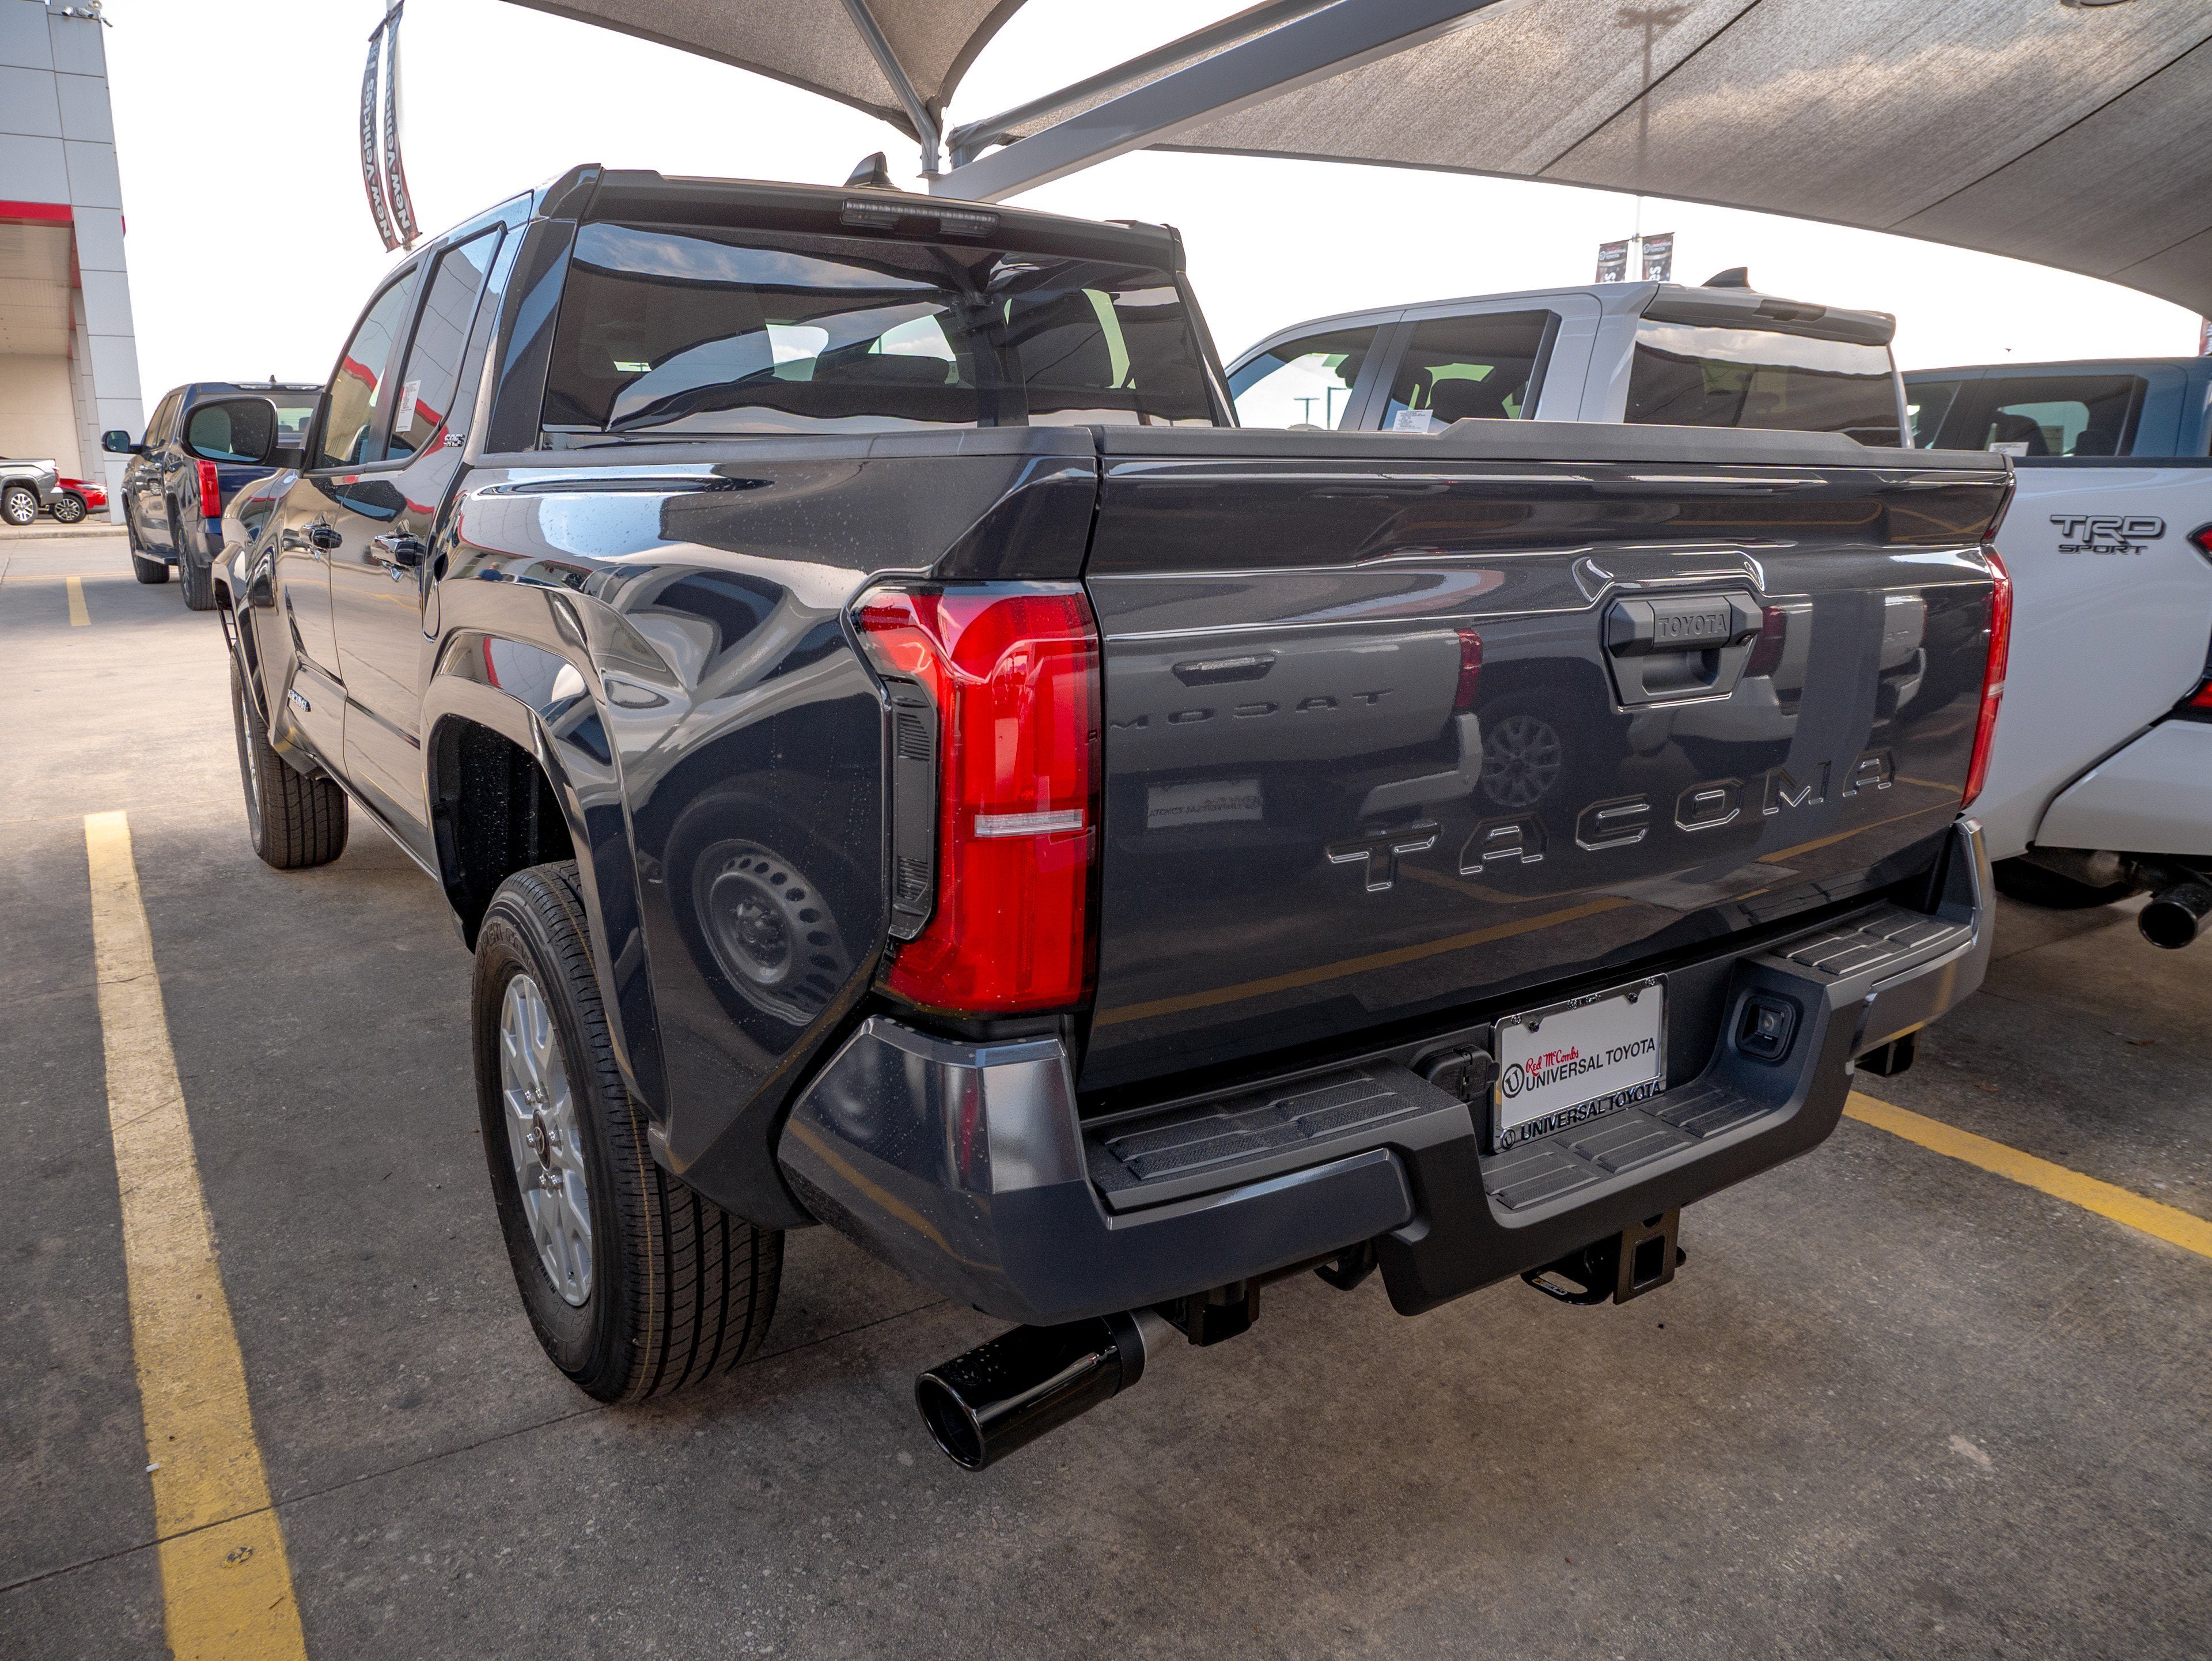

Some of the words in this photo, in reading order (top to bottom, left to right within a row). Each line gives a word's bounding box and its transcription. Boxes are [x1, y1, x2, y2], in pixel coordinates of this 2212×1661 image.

[363, 78, 375, 182] Vehicles
[370, 185, 391, 239] New
[391, 174, 411, 229] New
[2050, 514, 2166, 543] TRD
[2058, 544, 2147, 555] SPORT
[1658, 614, 1727, 638] TOYOTA
[1324, 748, 1896, 891] TACOMA
[1525, 1057, 1541, 1077] Red
[1526, 1055, 1603, 1091] UNIVERSAL
[1605, 1037, 1655, 1066] TOYOTA
[1521, 1098, 1605, 1141] UNIVERSAL
[1609, 1081, 1661, 1108] TOYOTA
